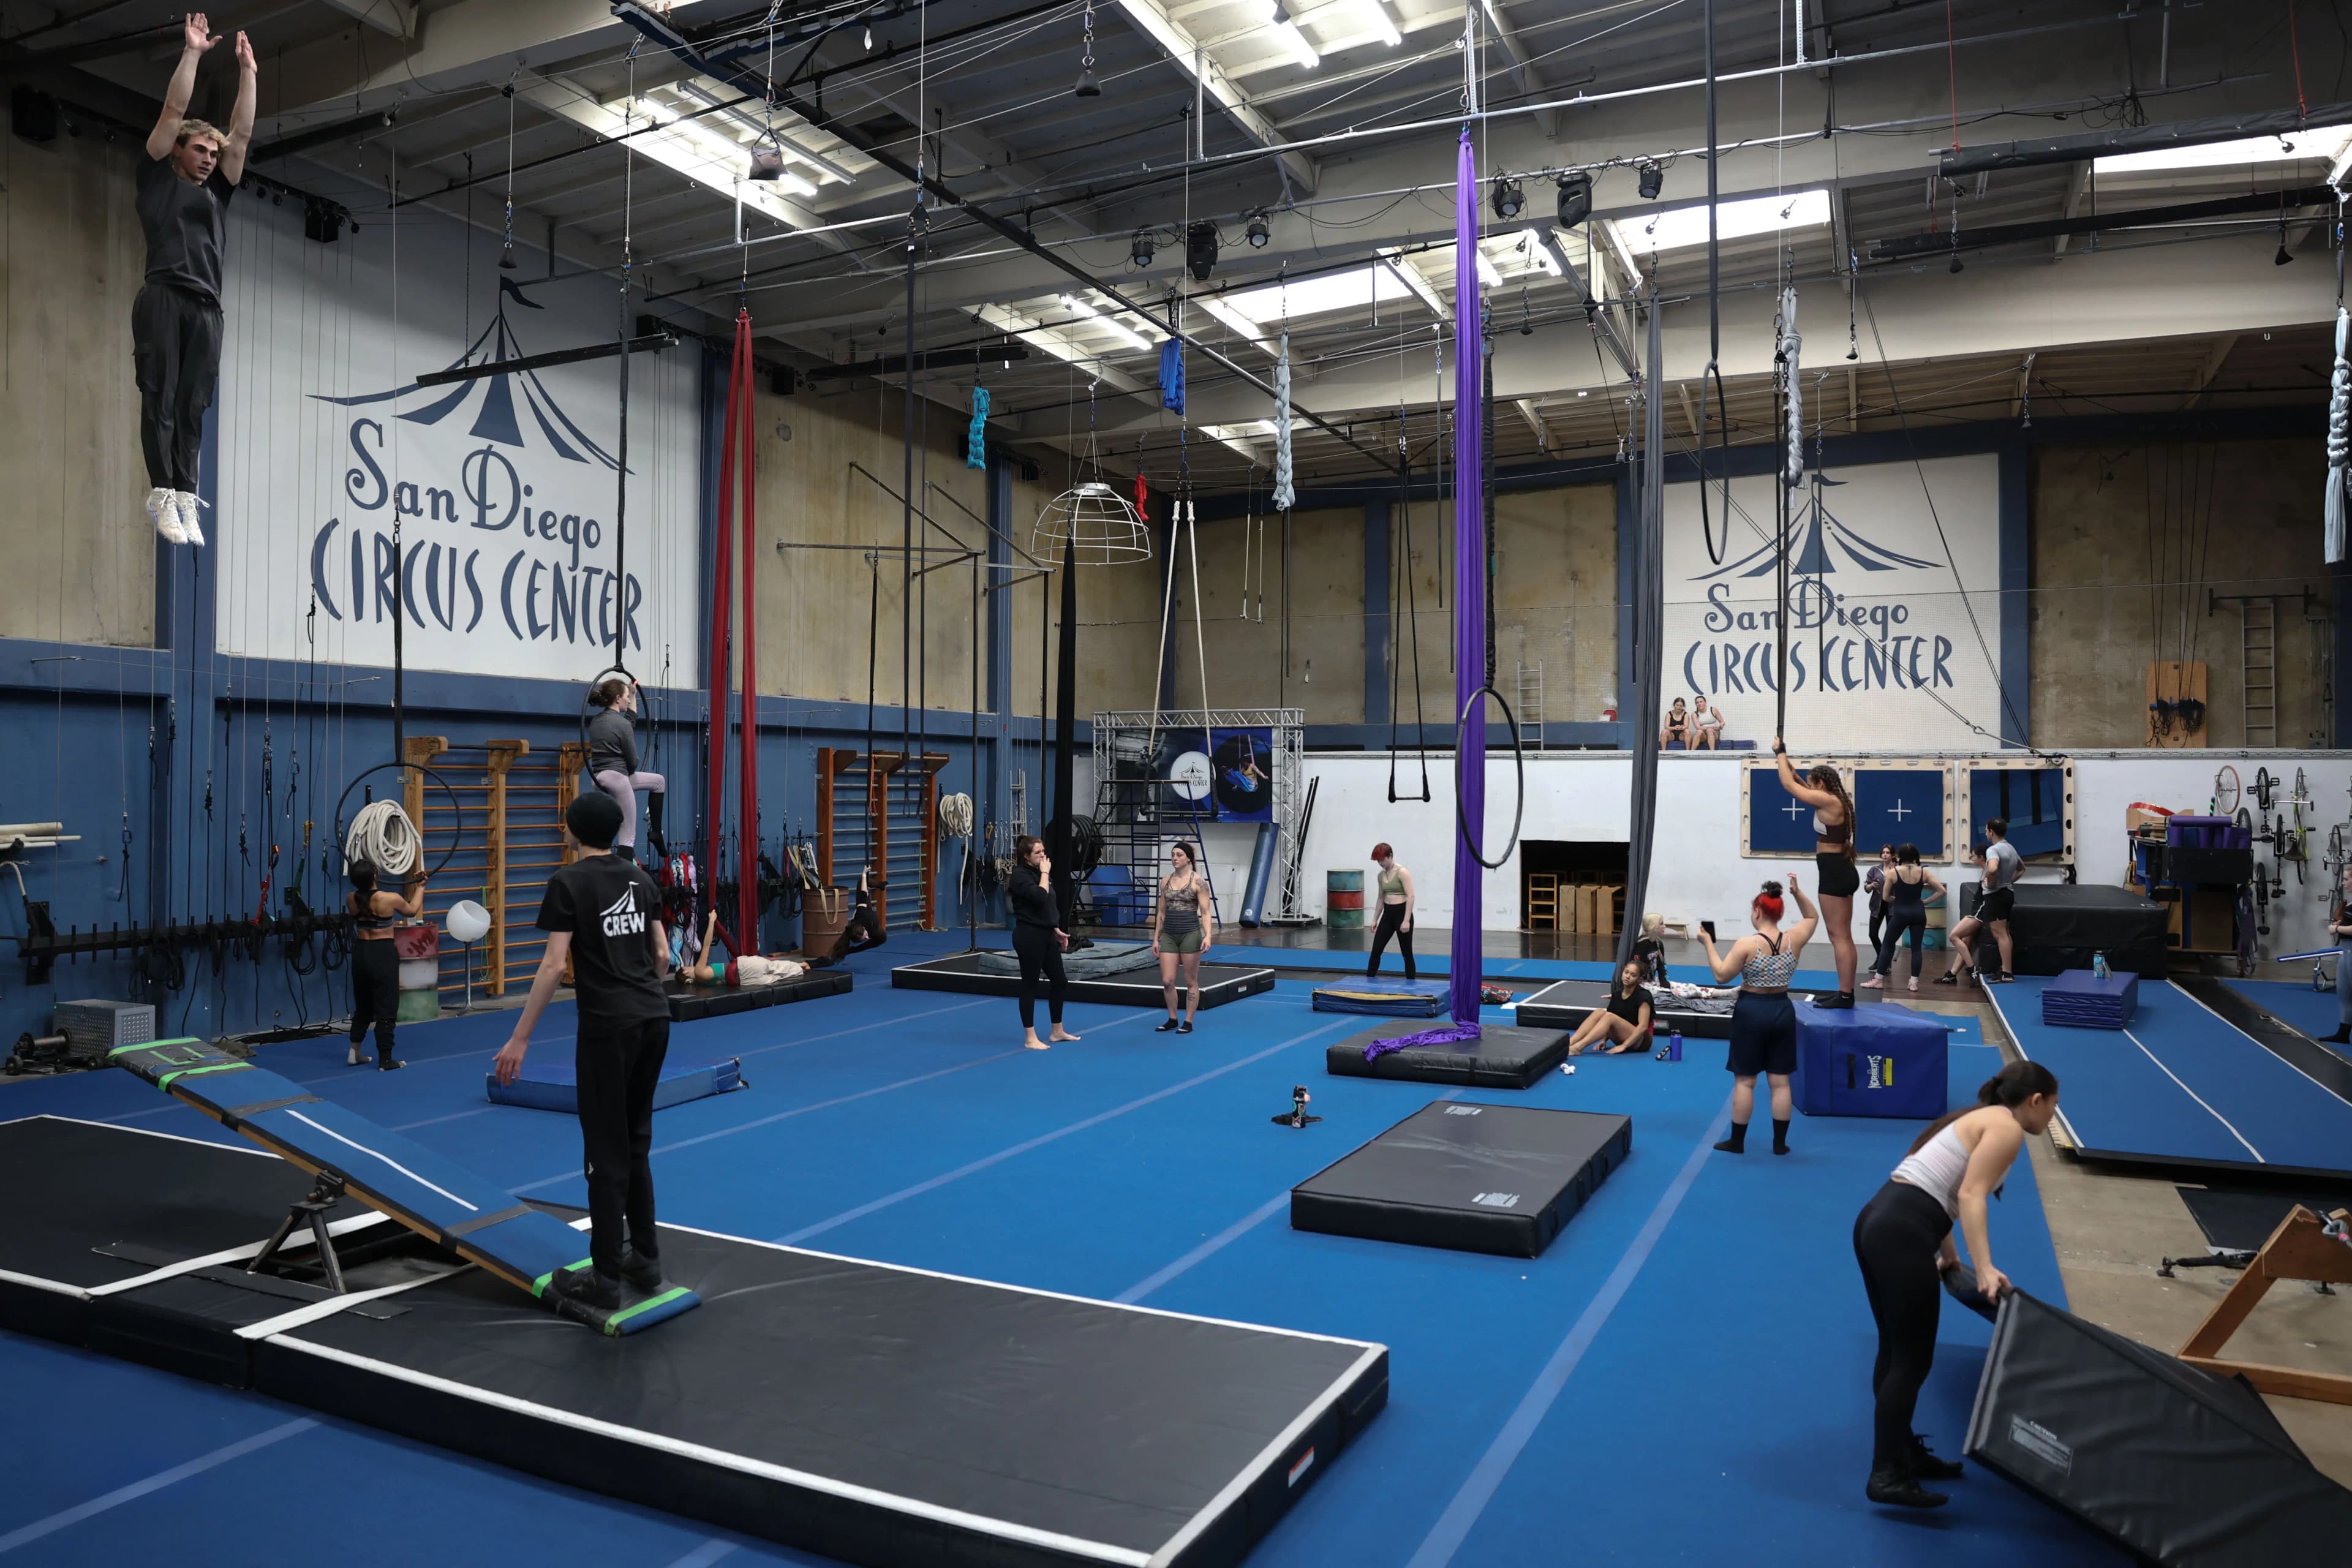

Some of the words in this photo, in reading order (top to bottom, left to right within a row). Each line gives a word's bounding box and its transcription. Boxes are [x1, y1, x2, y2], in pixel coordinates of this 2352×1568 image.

[345, 418, 459, 523] San
[462, 444, 601, 571] Diego
[311, 518, 483, 633] CIRCUS
[500, 549, 642, 652] CENTER
[1704, 582, 1785, 633] San
[1788, 576, 1909, 643] Diego
[1822, 635, 1954, 692] CENTER
[603, 912, 645, 937] CREW
